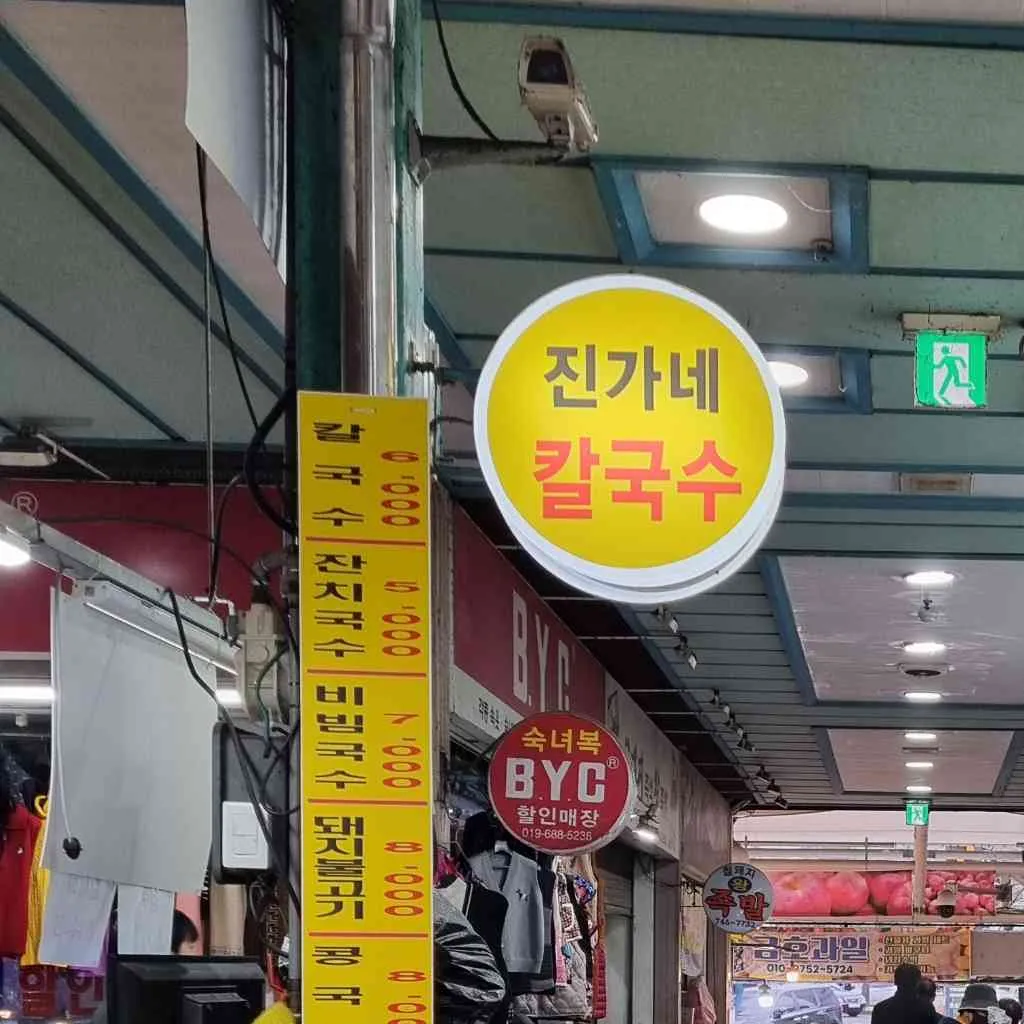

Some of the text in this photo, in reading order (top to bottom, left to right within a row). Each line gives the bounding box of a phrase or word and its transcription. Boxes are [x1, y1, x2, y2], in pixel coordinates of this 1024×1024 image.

[544, 344, 720, 414] 진가네
[312, 421, 366, 527] 칼국수
[534, 436, 743, 522] 칼국수
[313, 553, 368, 658] 잔치국수
[315, 685, 368, 790] 비빔국수
[521, 726, 602, 755] 숙녀복
[516, 804, 600, 829] 할인매장
[313, 816, 366, 920] 돼지불고기
[704, 888, 770, 922] 족발
